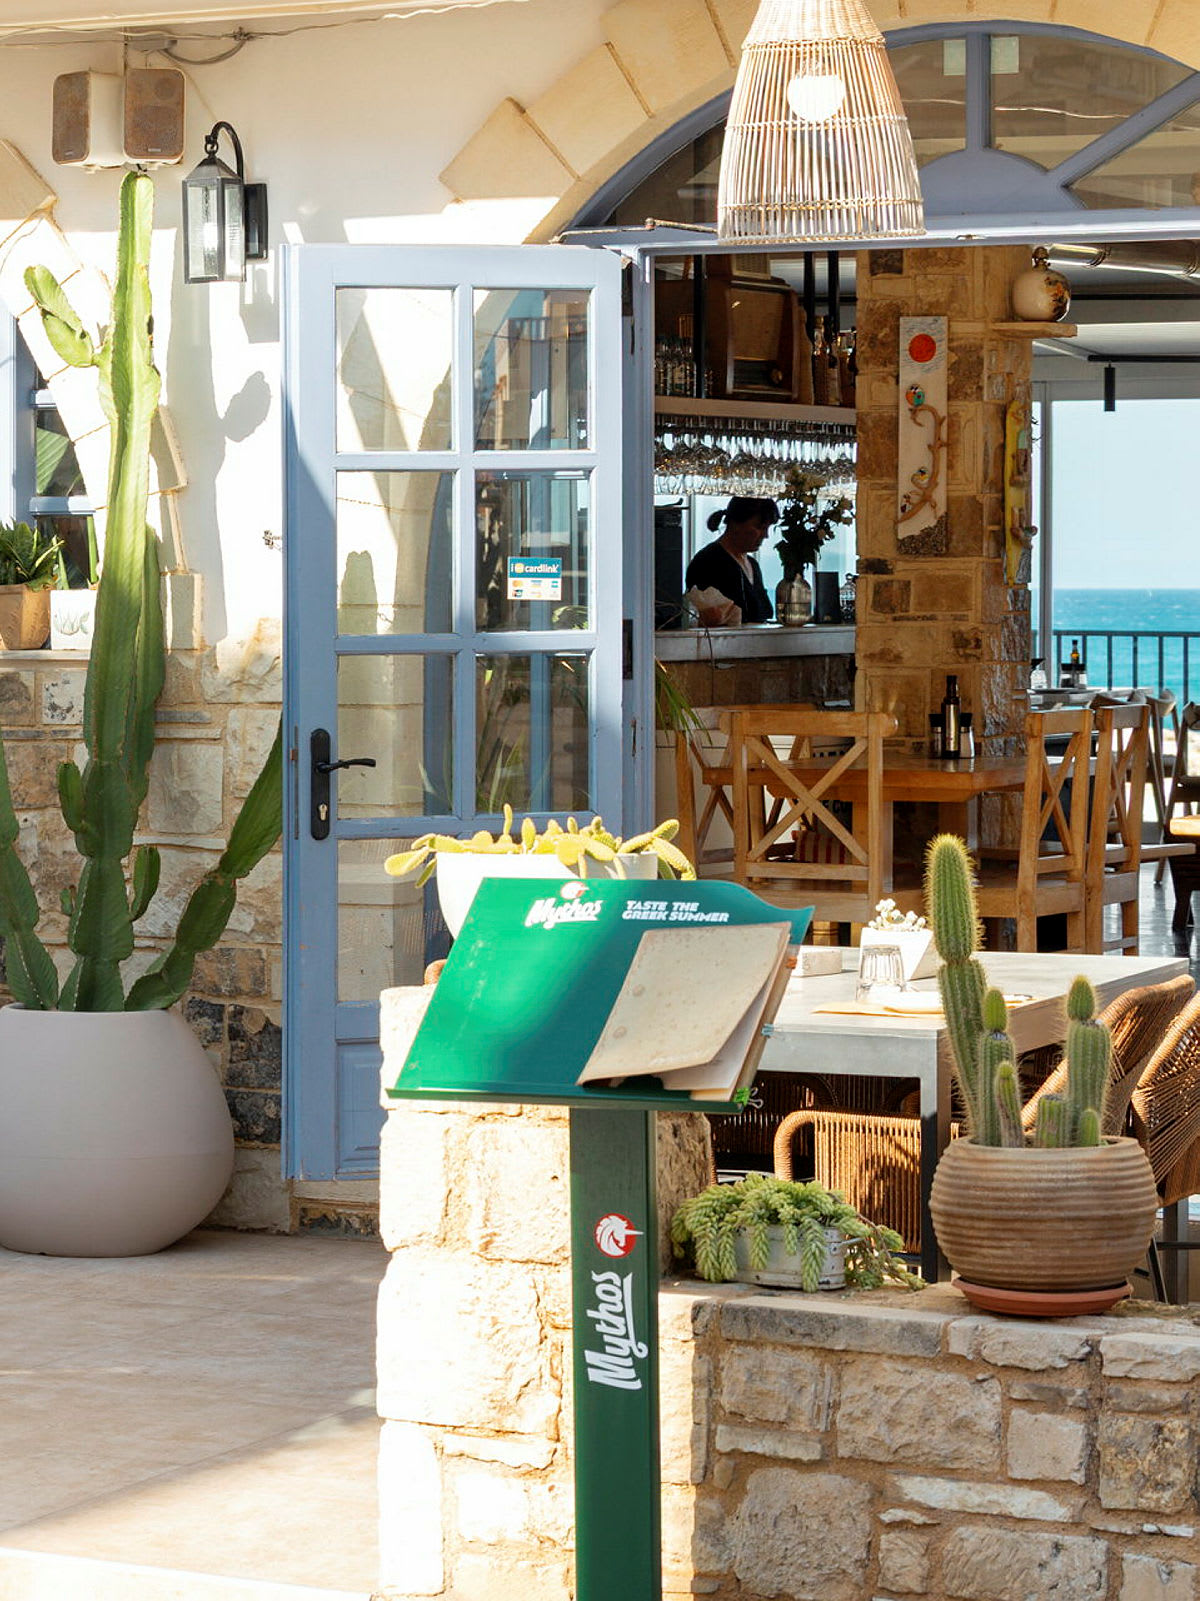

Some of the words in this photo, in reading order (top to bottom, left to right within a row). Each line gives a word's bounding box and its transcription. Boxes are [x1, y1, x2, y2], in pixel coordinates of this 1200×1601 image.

[525, 563, 559, 573] cardlink
[626, 901, 667, 911] TASTE
[672, 902, 699, 911] THE
[524, 898, 603, 929] Mythos
[622, 910, 667, 920] GREEK
[669, 911, 729, 922] SUMMER
[584, 1270, 649, 1390] Mythos
